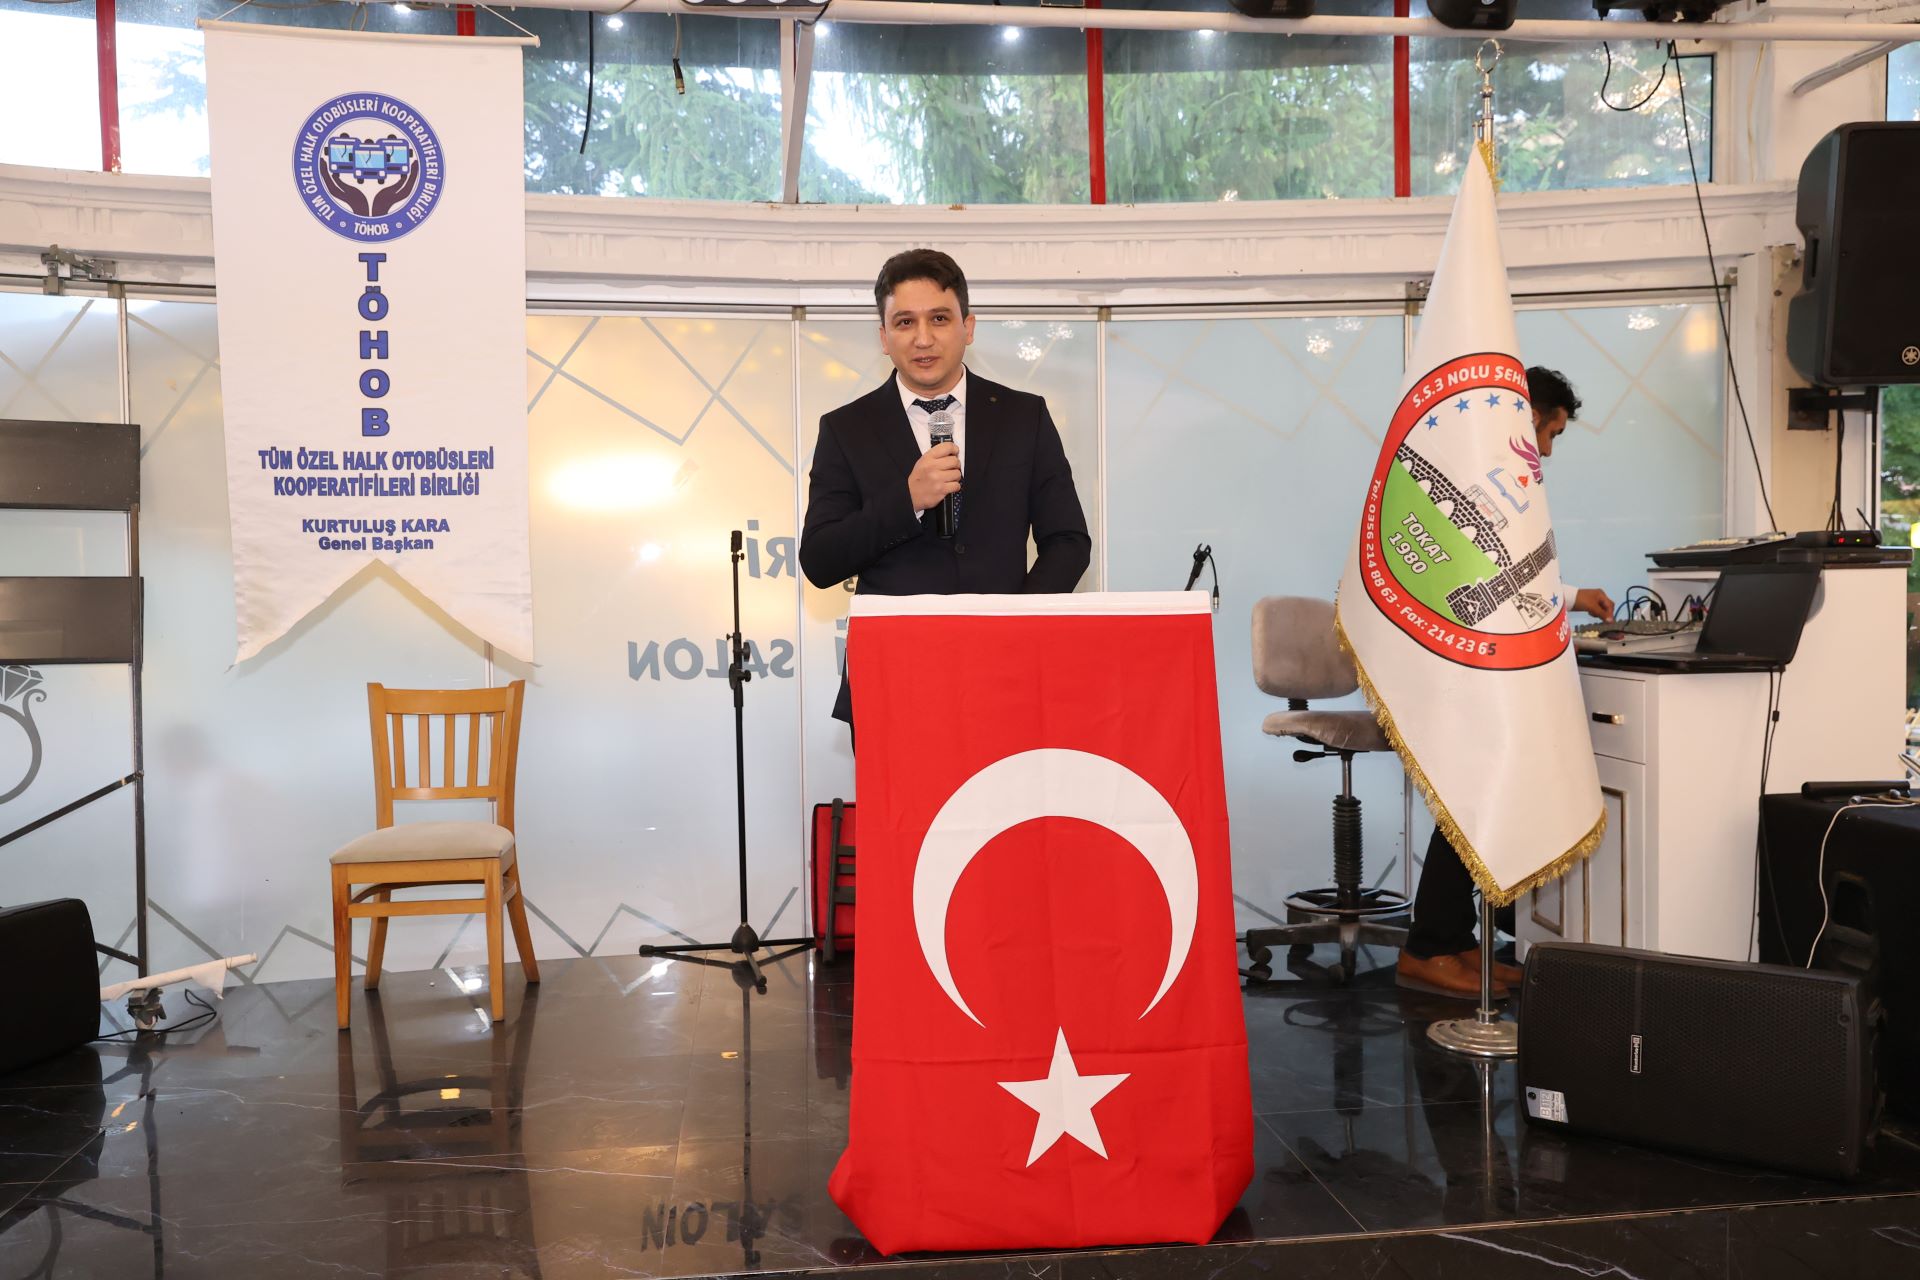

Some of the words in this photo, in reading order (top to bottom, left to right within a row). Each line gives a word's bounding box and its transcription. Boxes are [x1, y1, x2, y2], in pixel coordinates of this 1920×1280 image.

[312, 97, 379, 133] OTOBÜSLERİ
[300, 131, 318, 163] HALK
[381, 101, 441, 181] KOOPERATİFLERİ
[300, 165, 318, 195] ÖZEL
[311, 195, 336, 221] TÜM
[405, 182, 437, 224] BİRLİĞİ
[353, 221, 390, 236] TÖHOB
[358, 252, 390, 437] TÖHOB
[1447, 364, 1490, 386] NOLU
[258, 446, 293, 470] TÜM
[296, 446, 339, 470] ÖZEL
[343, 451, 388, 471] HALK
[392, 446, 495, 470] OTOBÜSLERİ
[273, 473, 416, 497] KOOPERATİFİLERİ
[420, 471, 480, 496] BİRLİĞİ
[1371, 479, 1381, 502] Tel:
[302, 519, 396, 536] KURTULUŞ
[401, 519, 450, 533] KARA
[1367, 505, 1376, 539] 0356
[318, 537, 366, 551] Genel
[372, 537, 434, 553] Başkan
[1401, 512, 1452, 564] TOKAT
[1366, 543, 1377, 568] 214
[1388, 532, 1428, 574] 1980
[1370, 570, 1386, 588] 88
[1380, 587, 1398, 603] 63
[1400, 606, 1429, 630] Fax:
[1427, 624, 1454, 646] 214
[1455, 637, 1475, 652] 23
[1477, 642, 1497, 656] 65
